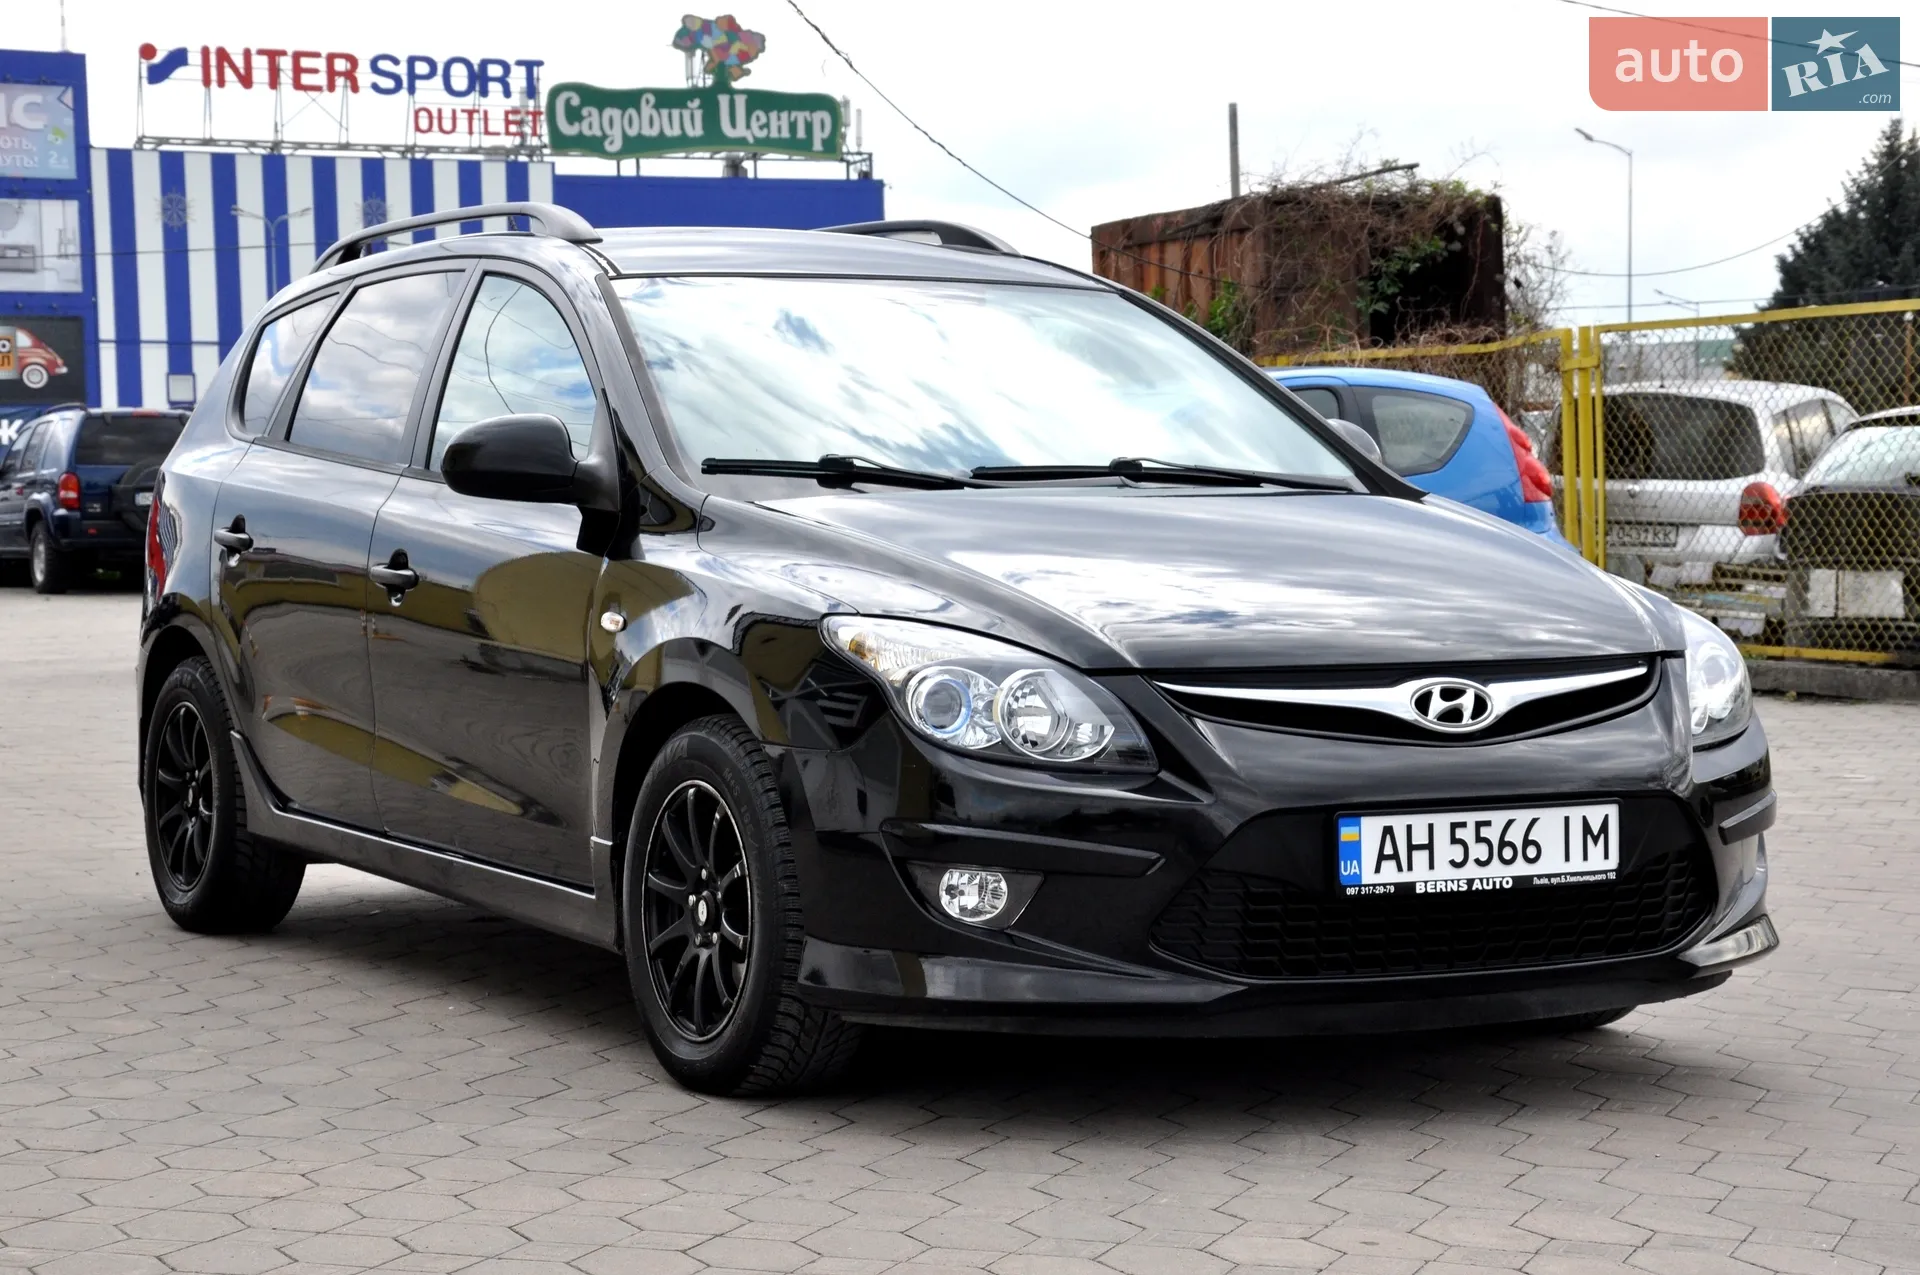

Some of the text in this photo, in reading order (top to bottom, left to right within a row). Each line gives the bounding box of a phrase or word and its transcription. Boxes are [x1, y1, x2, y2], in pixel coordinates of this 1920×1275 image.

[414, 107, 544, 137] OUTLET
[555, 91, 832, 152] Садовий Центр
[1374, 813, 1610, 874] AH 5566 IM
[1341, 860, 1360, 876] UA
[1346, 885, 1395, 896] 097 317-29-79
[1415, 877, 1513, 894] BERNS AUTO
